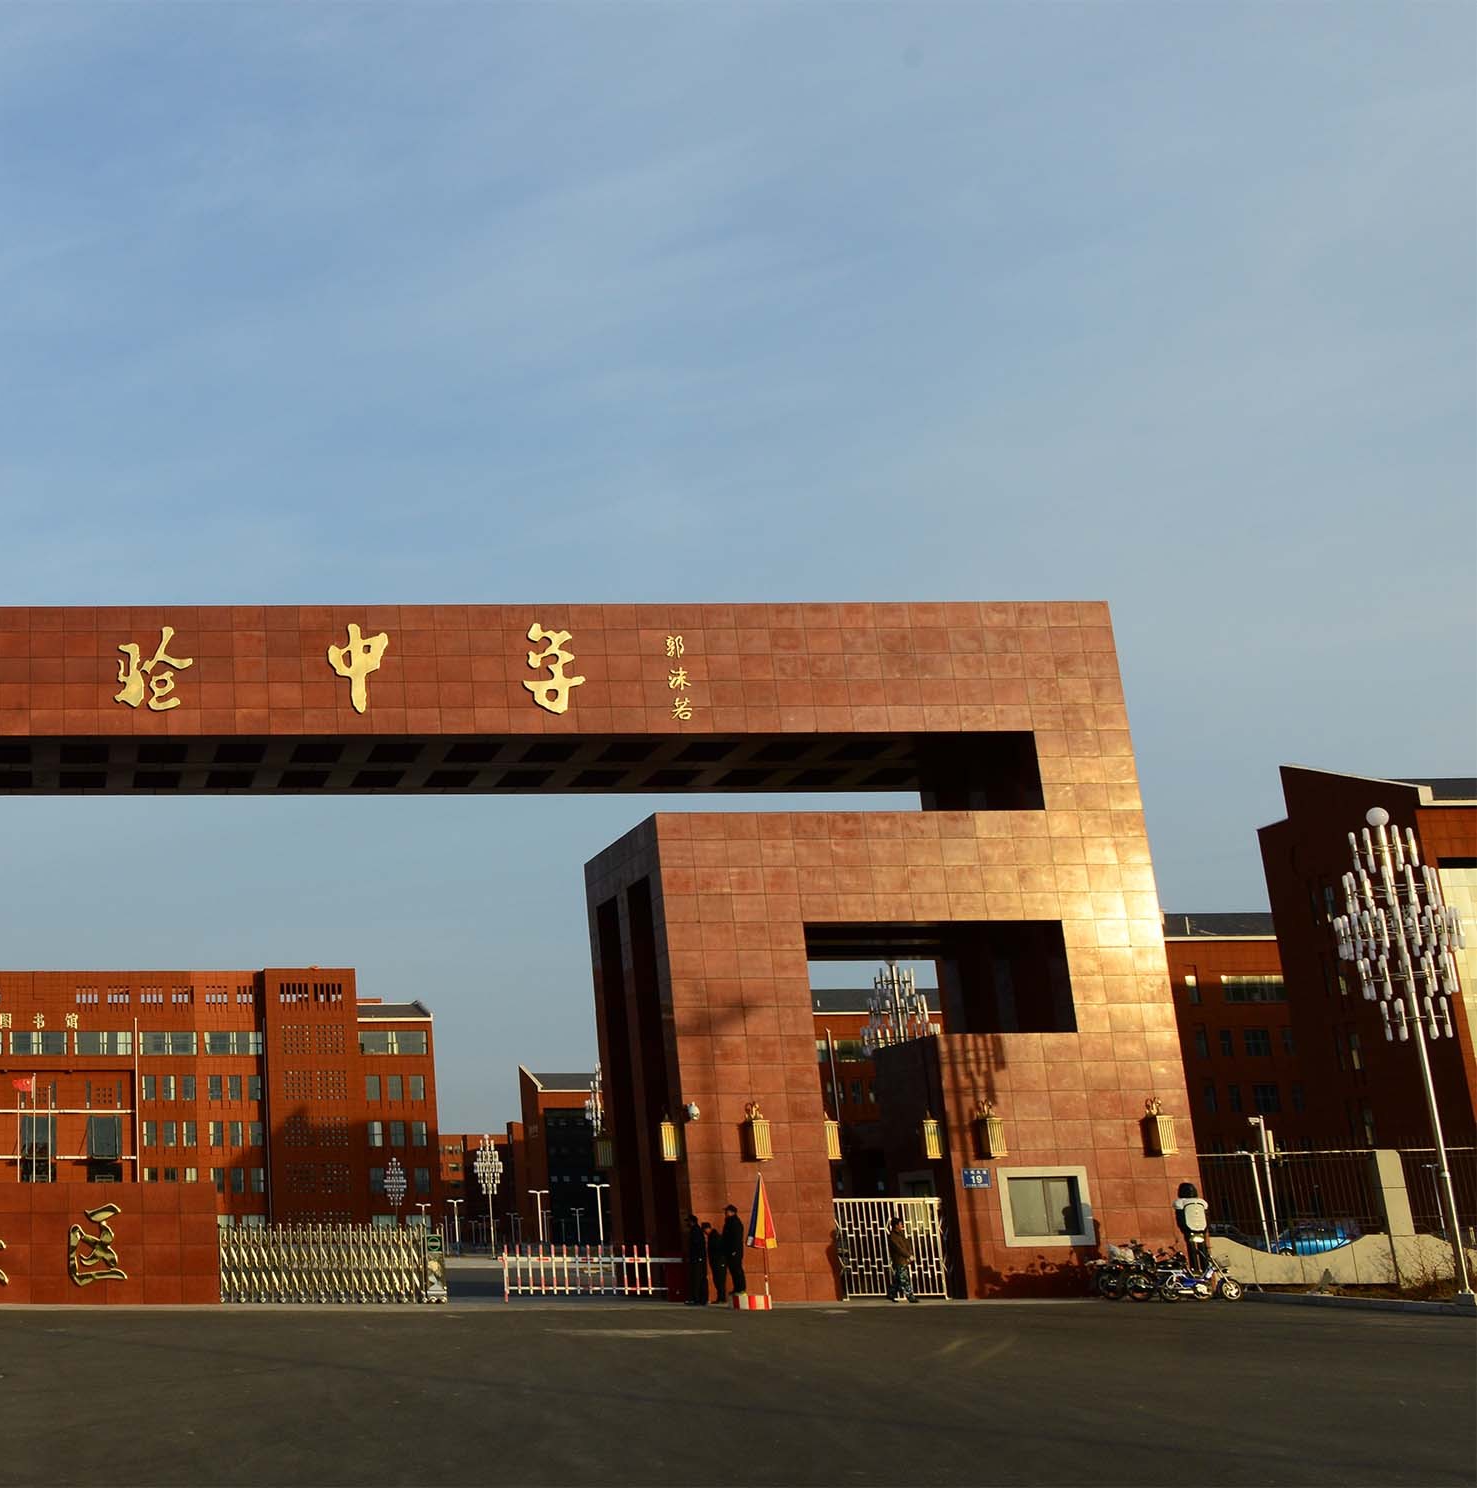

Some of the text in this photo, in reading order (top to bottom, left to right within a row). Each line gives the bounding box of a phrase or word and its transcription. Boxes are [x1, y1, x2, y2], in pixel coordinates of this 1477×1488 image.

[665, 635, 693, 720] 郭沫若
[0, 1012, 79, 1030] 图书馆
[970, 1175, 983, 1184] 19
